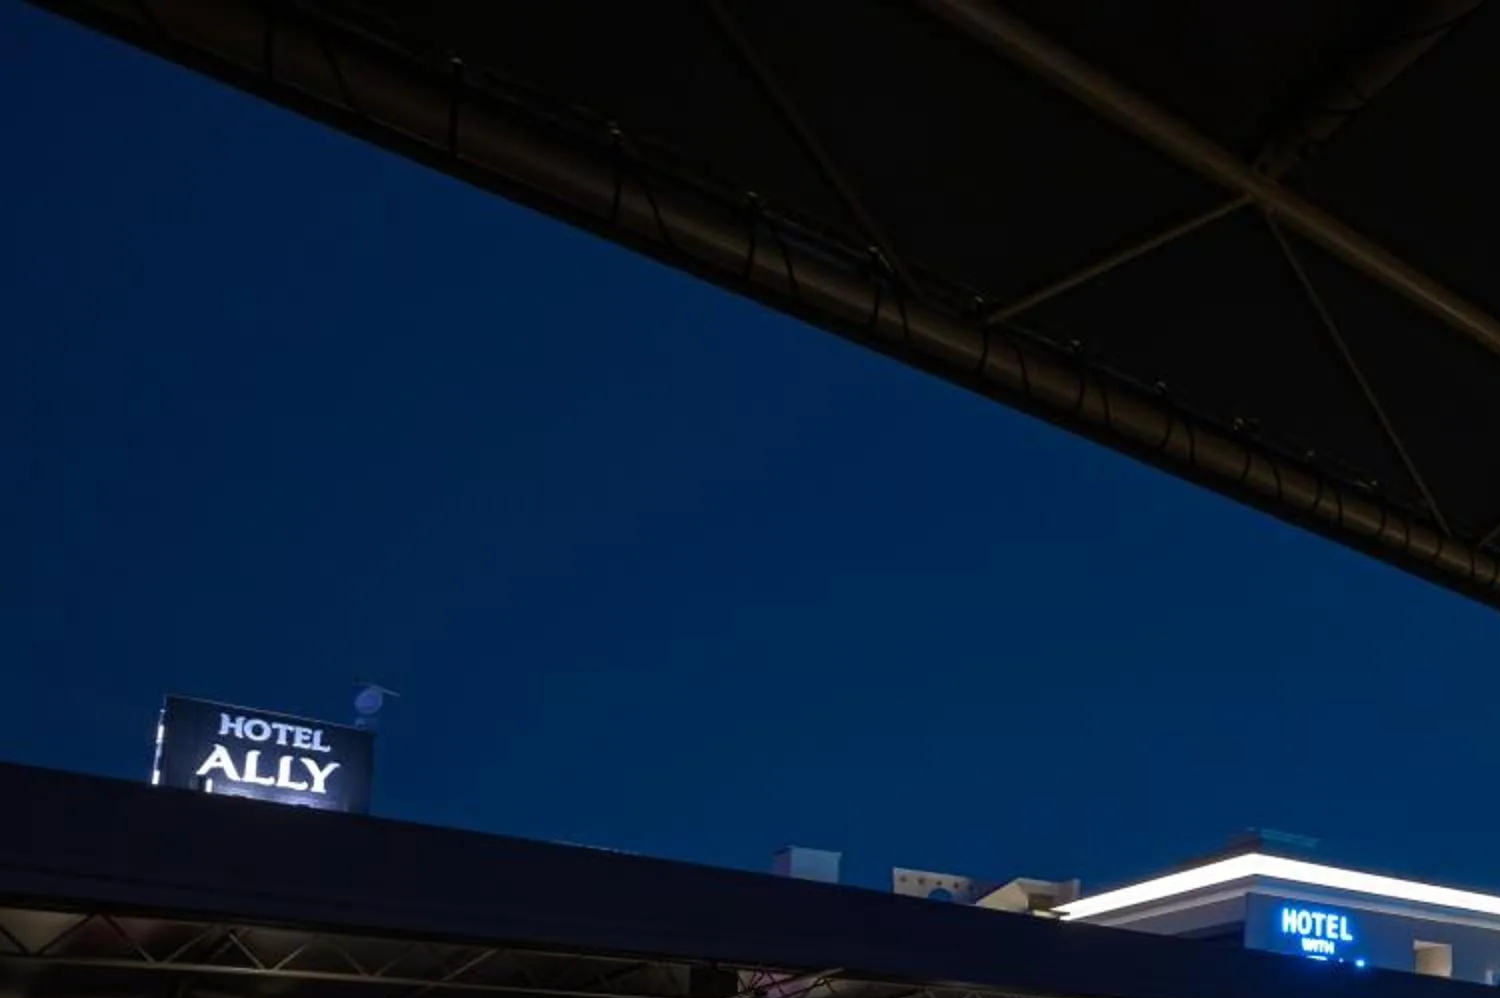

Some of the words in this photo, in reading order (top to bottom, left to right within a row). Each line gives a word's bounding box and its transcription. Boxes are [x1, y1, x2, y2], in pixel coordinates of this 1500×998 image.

[219, 713, 331, 752] HOTEL
[196, 744, 340, 793] ALLY
[1282, 908, 1353, 941] HOTEL
